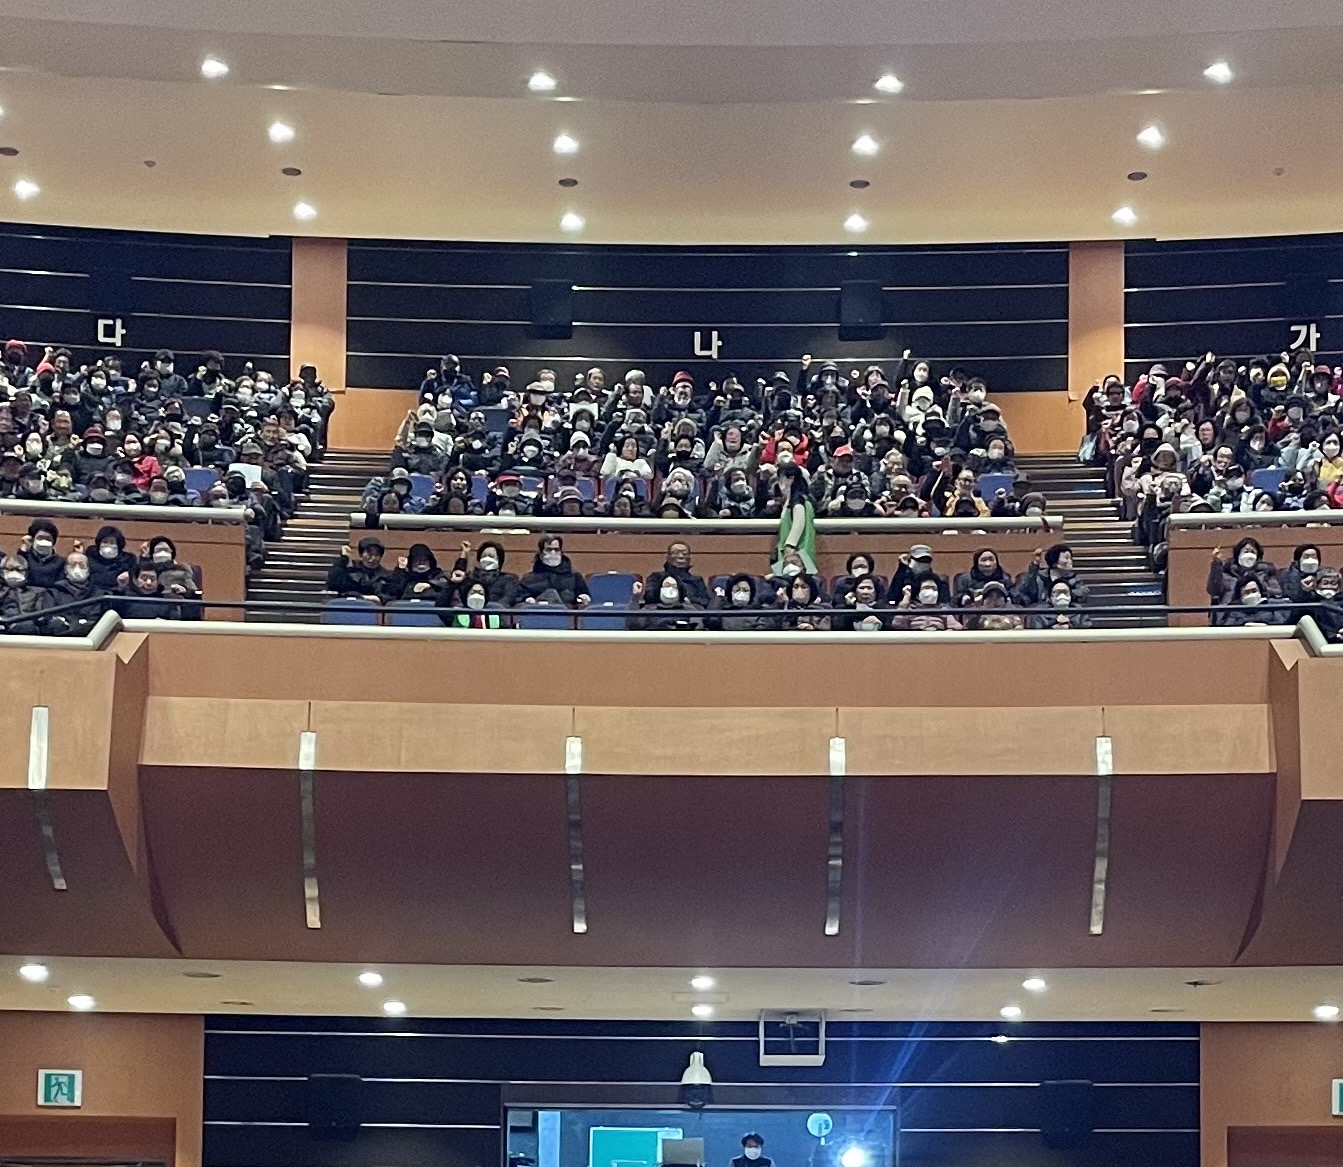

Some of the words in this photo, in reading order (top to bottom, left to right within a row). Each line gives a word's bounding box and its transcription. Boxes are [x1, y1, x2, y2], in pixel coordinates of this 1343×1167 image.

[97, 318, 127, 347] 다
[694, 330, 723, 359] 나
[1289, 323, 1321, 352] 가
